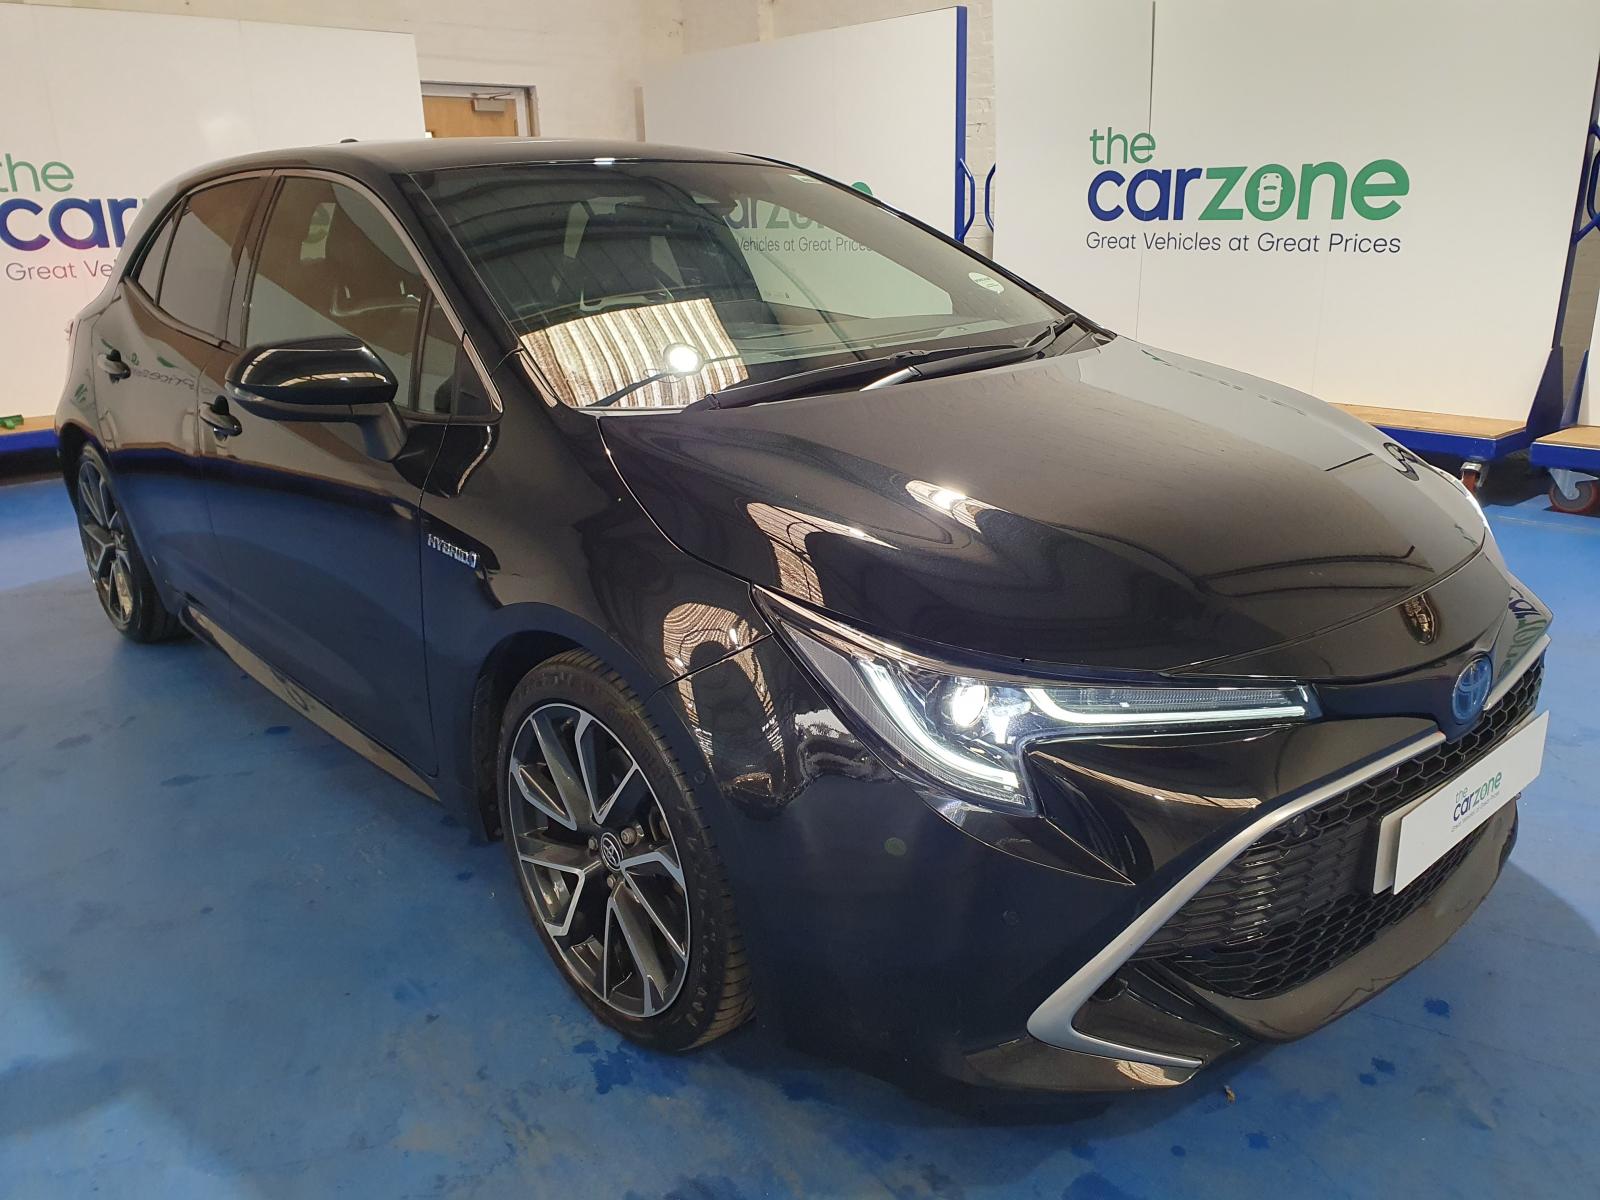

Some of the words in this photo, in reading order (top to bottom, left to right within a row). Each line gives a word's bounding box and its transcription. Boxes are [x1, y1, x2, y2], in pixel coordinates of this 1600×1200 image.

[1089, 127, 1156, 165] the
[1087, 159, 1410, 221] carzone
[783, 240, 795, 252] at
[798, 236, 832, 252] Great
[1086, 231, 1137, 249] Great
[1143, 231, 1221, 251] Vehicles
[1228, 234, 1249, 251] at
[1257, 232, 1320, 252] Great
[1328, 233, 1401, 253] Prices
[5, 261, 77, 281] Great
[1453, 772, 1502, 821] carzone
